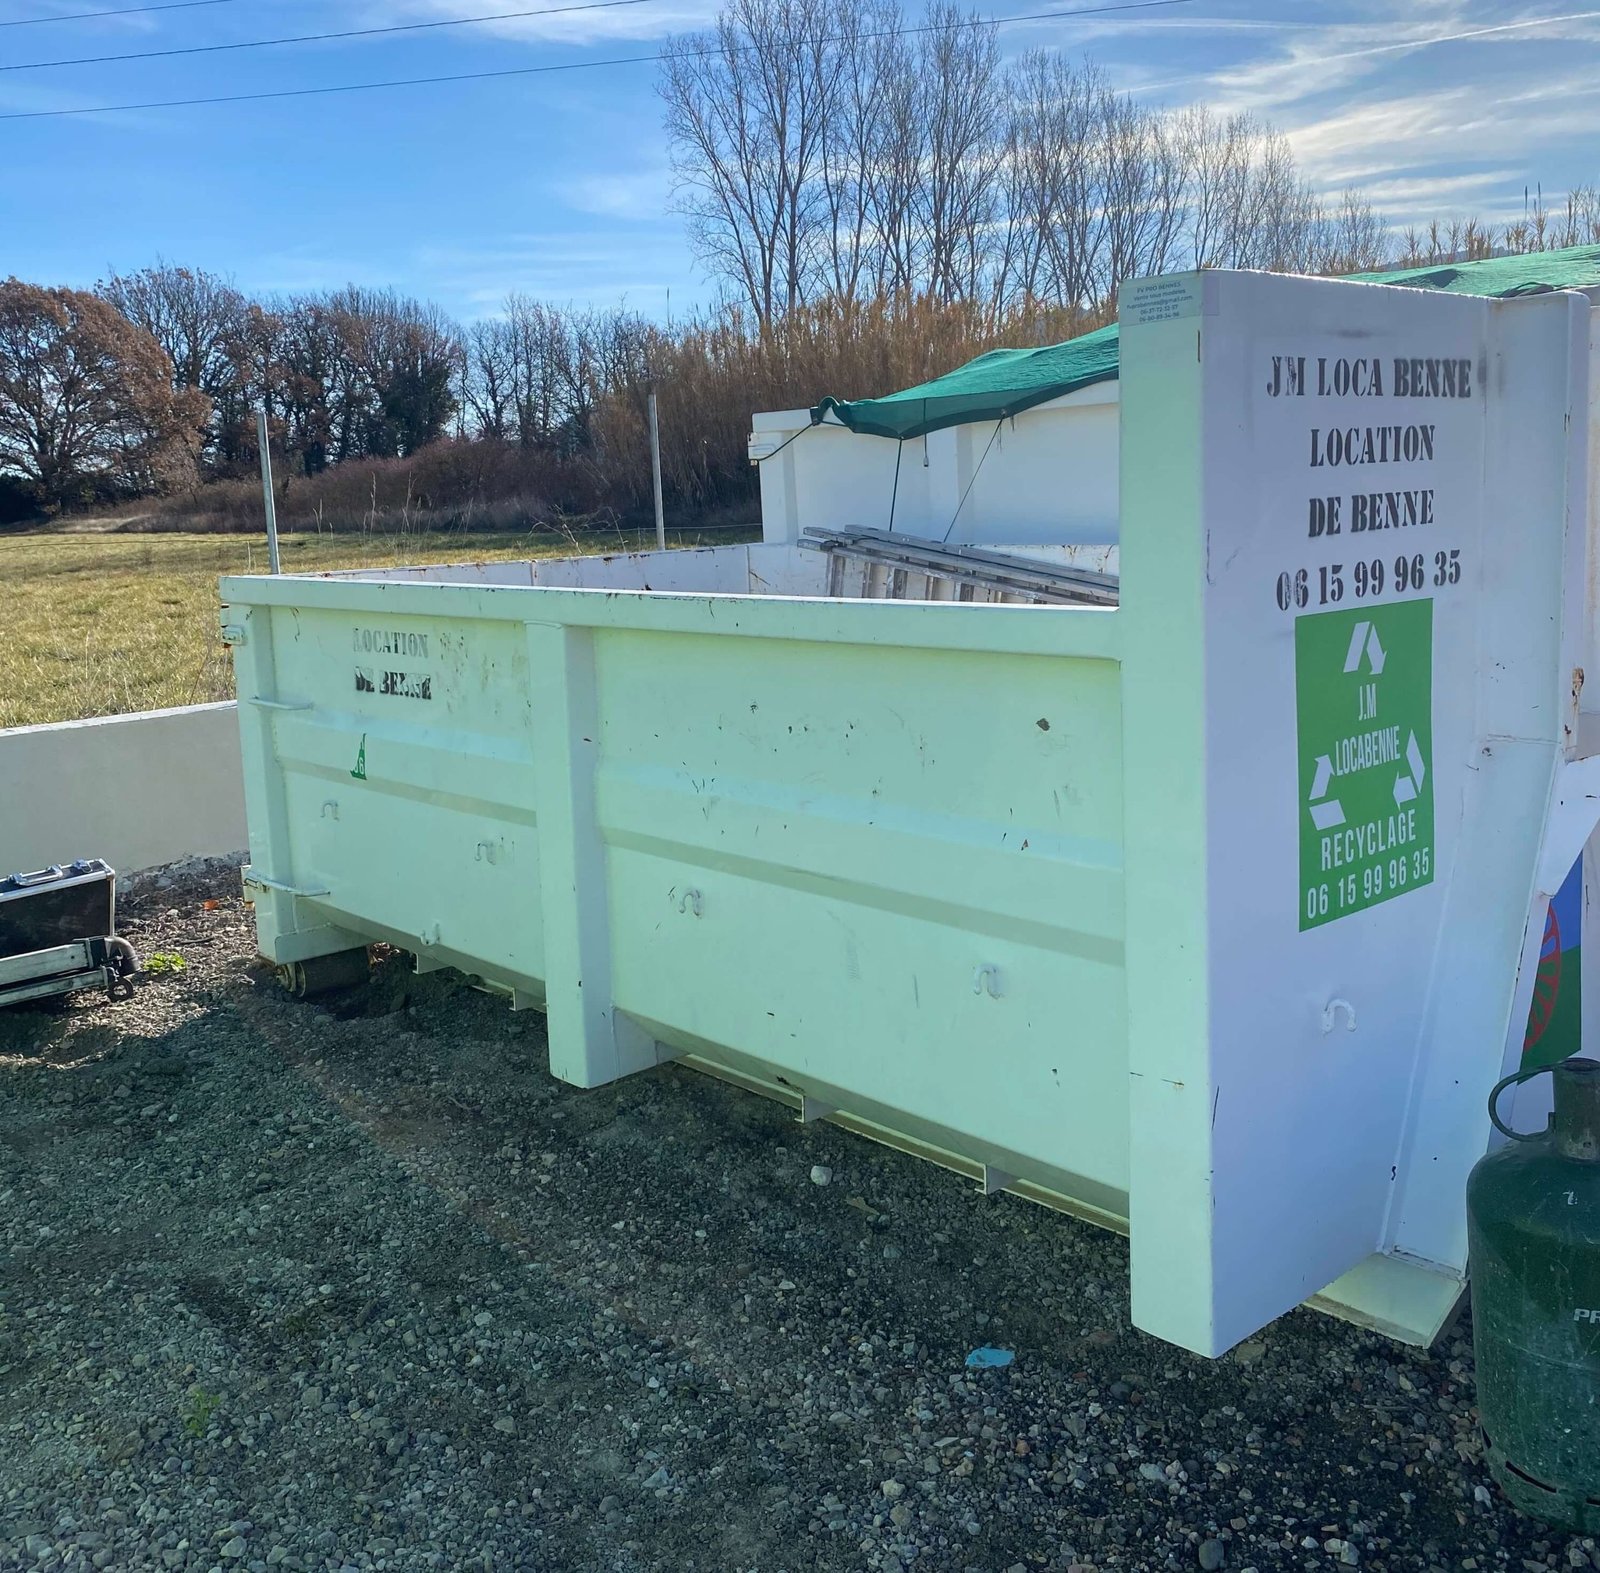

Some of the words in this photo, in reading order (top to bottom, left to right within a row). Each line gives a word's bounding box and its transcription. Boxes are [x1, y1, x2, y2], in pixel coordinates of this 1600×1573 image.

[1266, 356, 1306, 397] JM
[1317, 357, 1384, 397] LOCA
[1393, 357, 1472, 399] BENNE
[1309, 424, 1436, 467] LOCATION
[1308, 496, 1342, 538] DE
[1350, 489, 1434, 533] BENNE
[1276, 568, 1309, 611] 06
[1318, 564, 1344, 605] 15
[1353, 558, 1385, 598] 99
[1394, 553, 1425, 593] 96
[1433, 549, 1461, 587] 35
[352, 627, 429, 659] LOCATION
[1358, 683, 1377, 721] J.M
[1335, 725, 1401, 777] LOCABENNE
[1321, 809, 1416, 872] RECYCLAGE
[1307, 884, 1329, 919] 06
[1338, 874, 1357, 908] 15
[1364, 864, 1383, 899] 99
[1389, 855, 1407, 889] 96
[1413, 847, 1430, 880] 35
